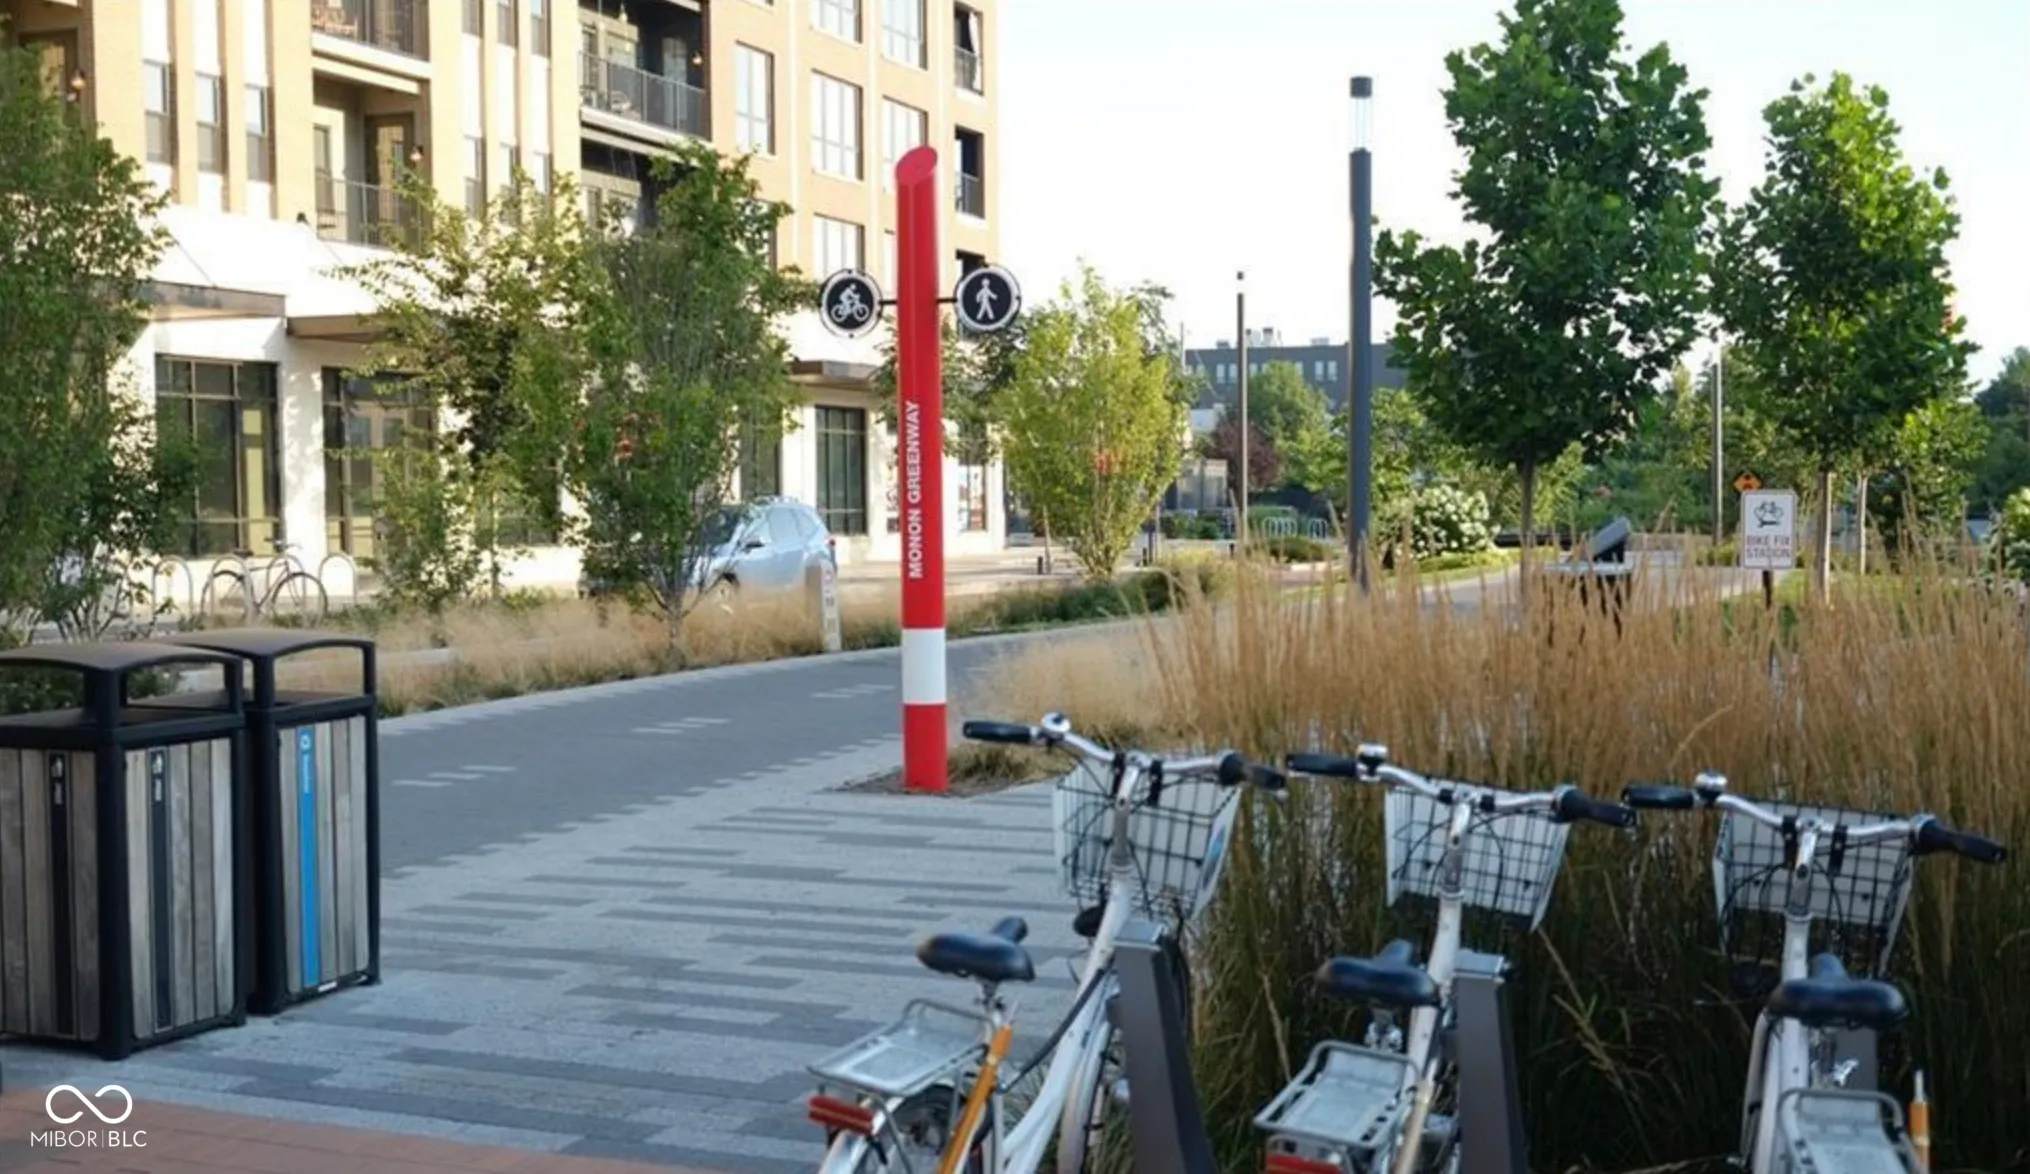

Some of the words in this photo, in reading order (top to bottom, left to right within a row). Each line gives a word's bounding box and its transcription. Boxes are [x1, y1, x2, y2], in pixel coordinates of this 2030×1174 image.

[906, 400, 921, 504] GREENWAY
[908, 509, 923, 578] MONON
[1746, 534, 1768, 546] BIKE
[1773, 534, 1790, 546] FIX
[1746, 548, 1790, 559] STATION
